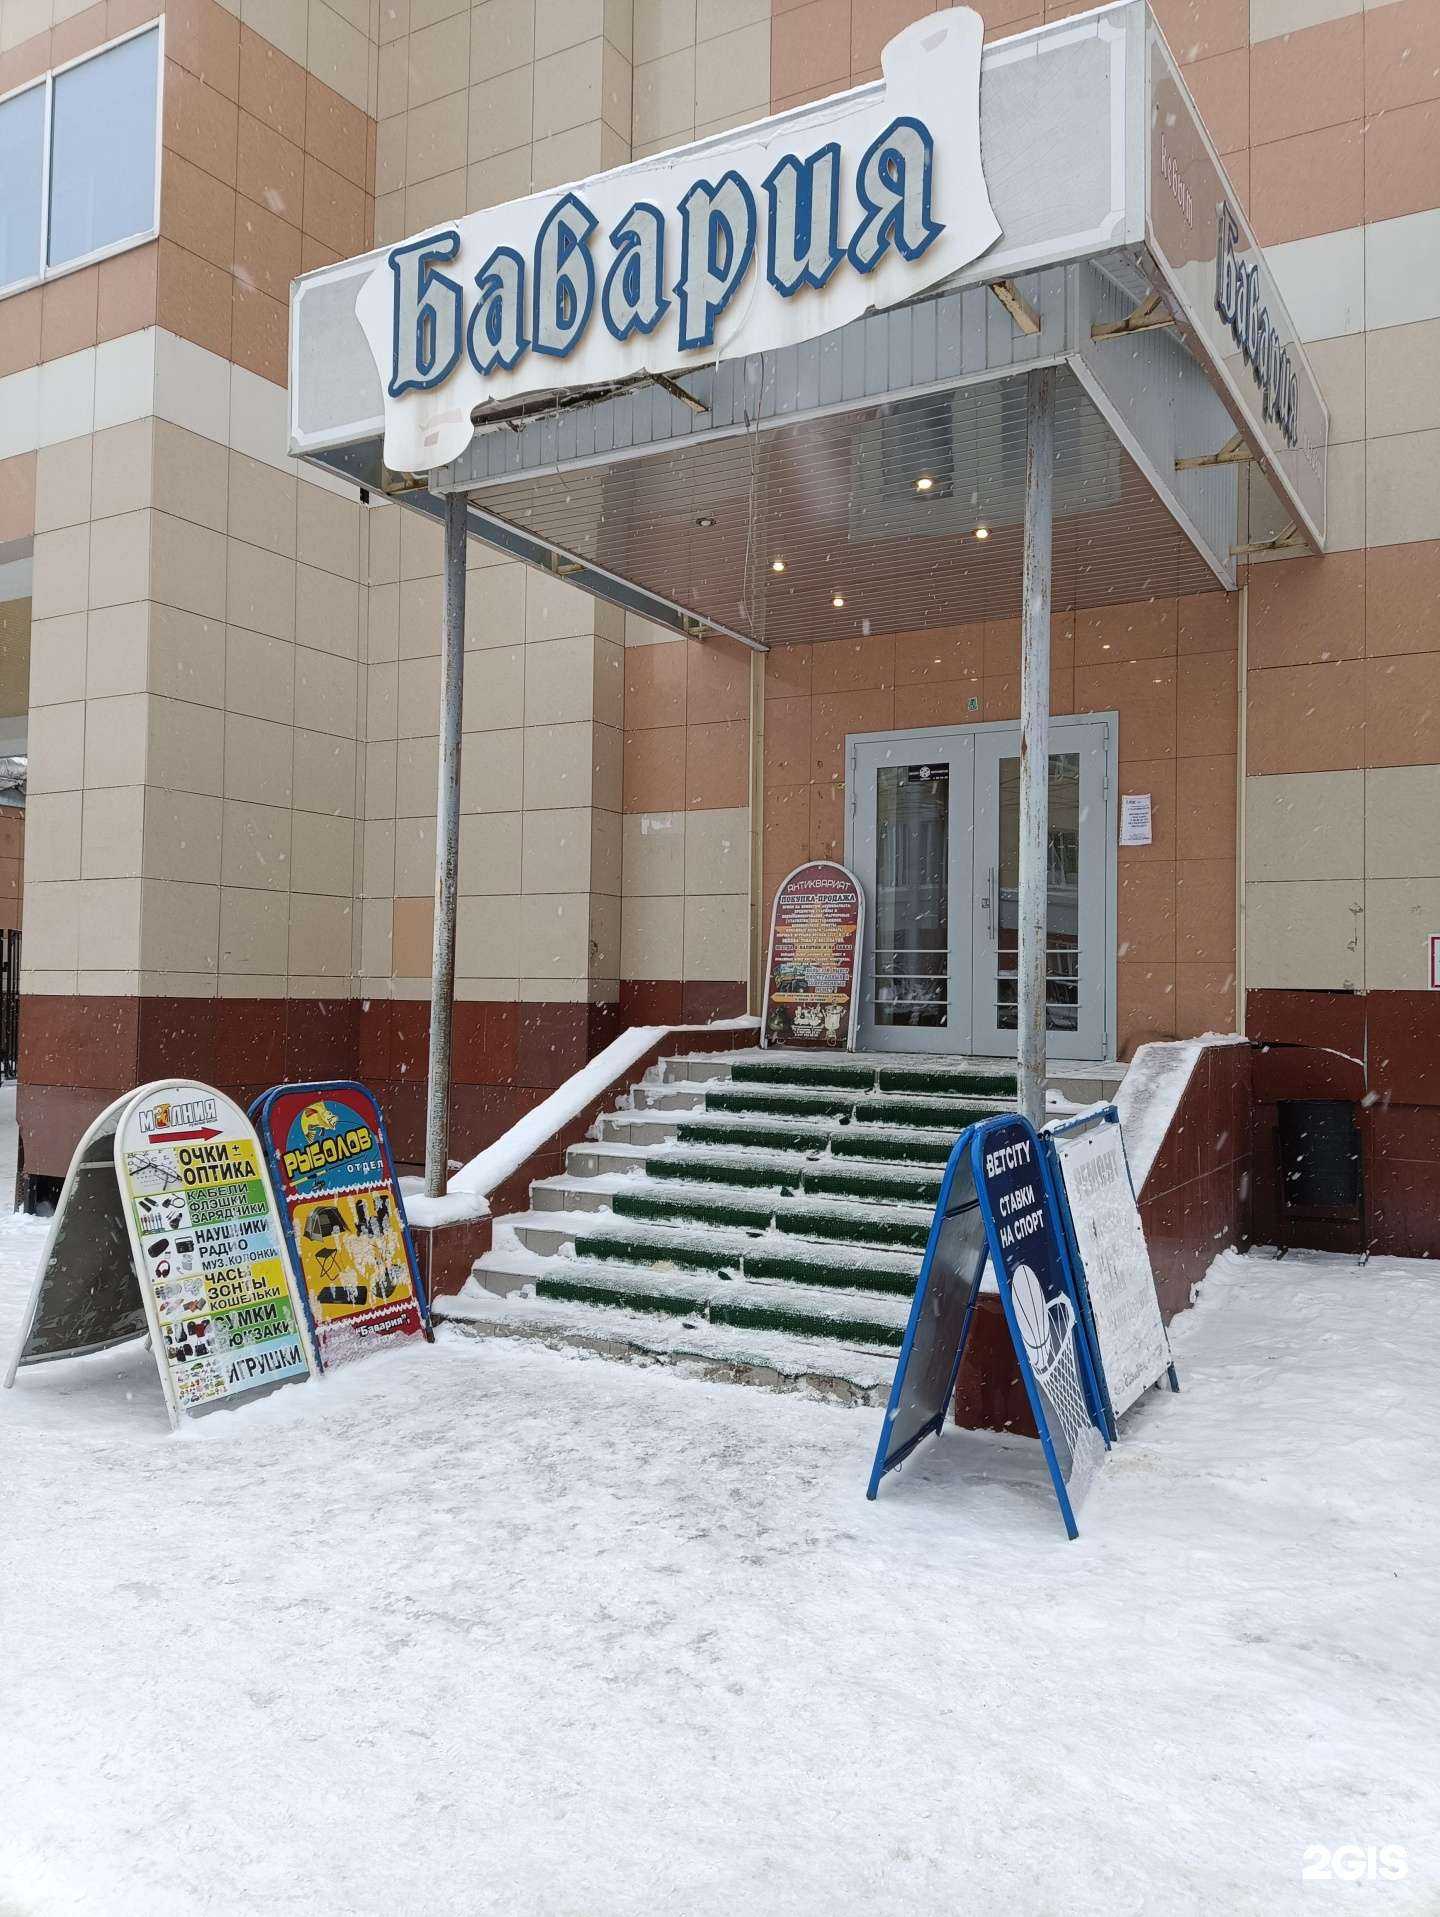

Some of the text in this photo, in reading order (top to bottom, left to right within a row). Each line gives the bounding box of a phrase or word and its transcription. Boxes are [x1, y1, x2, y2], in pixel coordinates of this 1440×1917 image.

[389, 116, 946, 398] Бавария
[1215, 199, 1298, 448] Бавария
[780, 893, 856, 904] ПОКУПКА-ПРОДАЖА
[787, 880, 851, 893] АНТИКВАРИАТ
[179, 1144, 229, 1167] ОЧКИ
[282, 1126, 373, 1178] РЫБОЛОВ
[986, 1140, 1031, 1178] BETCITY
[183, 1160, 256, 1186] ОПТИКА
[346, 1159, 384, 1174] ОТДЕЛ
[187, 1183, 248, 1201] КАБЕЛИ
[190, 1194, 247, 1212] ФЛЭШКИ
[1000, 1184, 1035, 1217] СТАВКИ
[192, 1202, 266, 1224] ЗАРЯДЧИКИ
[1000, 1209, 1044, 1249] НА СПОРТ
[199, 1239, 248, 1258] РАДИО
[208, 1276, 267, 1300] ЗОНТЫ
[210, 1286, 281, 1311] КОШЕЛЬКИ
[214, 1303, 277, 1332] СУМКИ
[226, 1320, 292, 1348] ЮКЗАКИ
[229, 1344, 302, 1384] ИГРУШКИ
